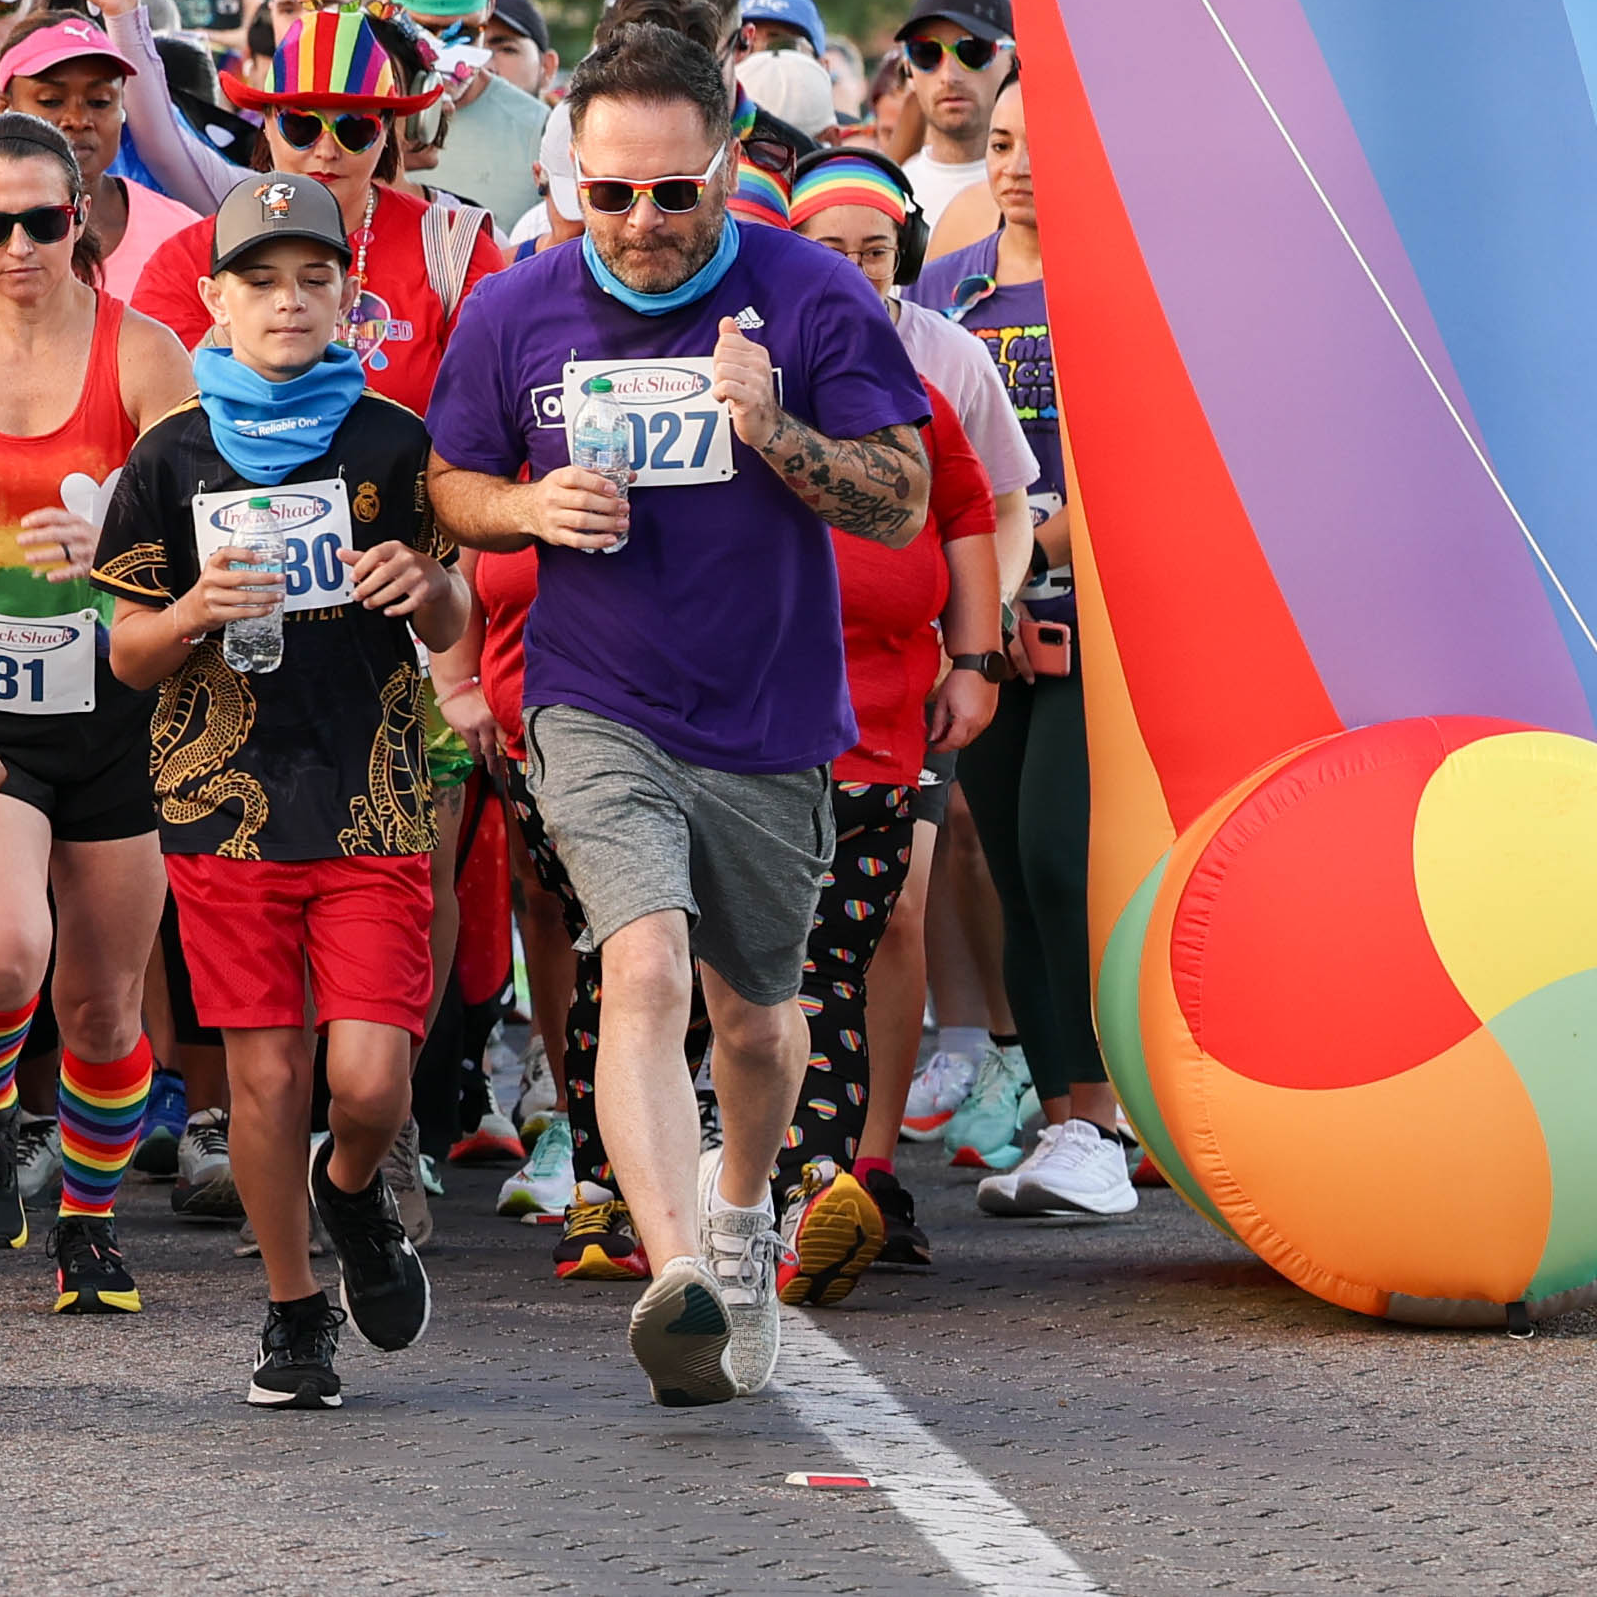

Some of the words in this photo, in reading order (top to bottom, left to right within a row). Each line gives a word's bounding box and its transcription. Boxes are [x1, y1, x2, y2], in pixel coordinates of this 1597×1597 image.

[611, 376, 646, 394] ack
[646, 375, 703, 393] Shack
[258, 420, 297, 436] Reliable
[269, 499, 325, 520] Shack
[19, 627, 73, 643] Shack
